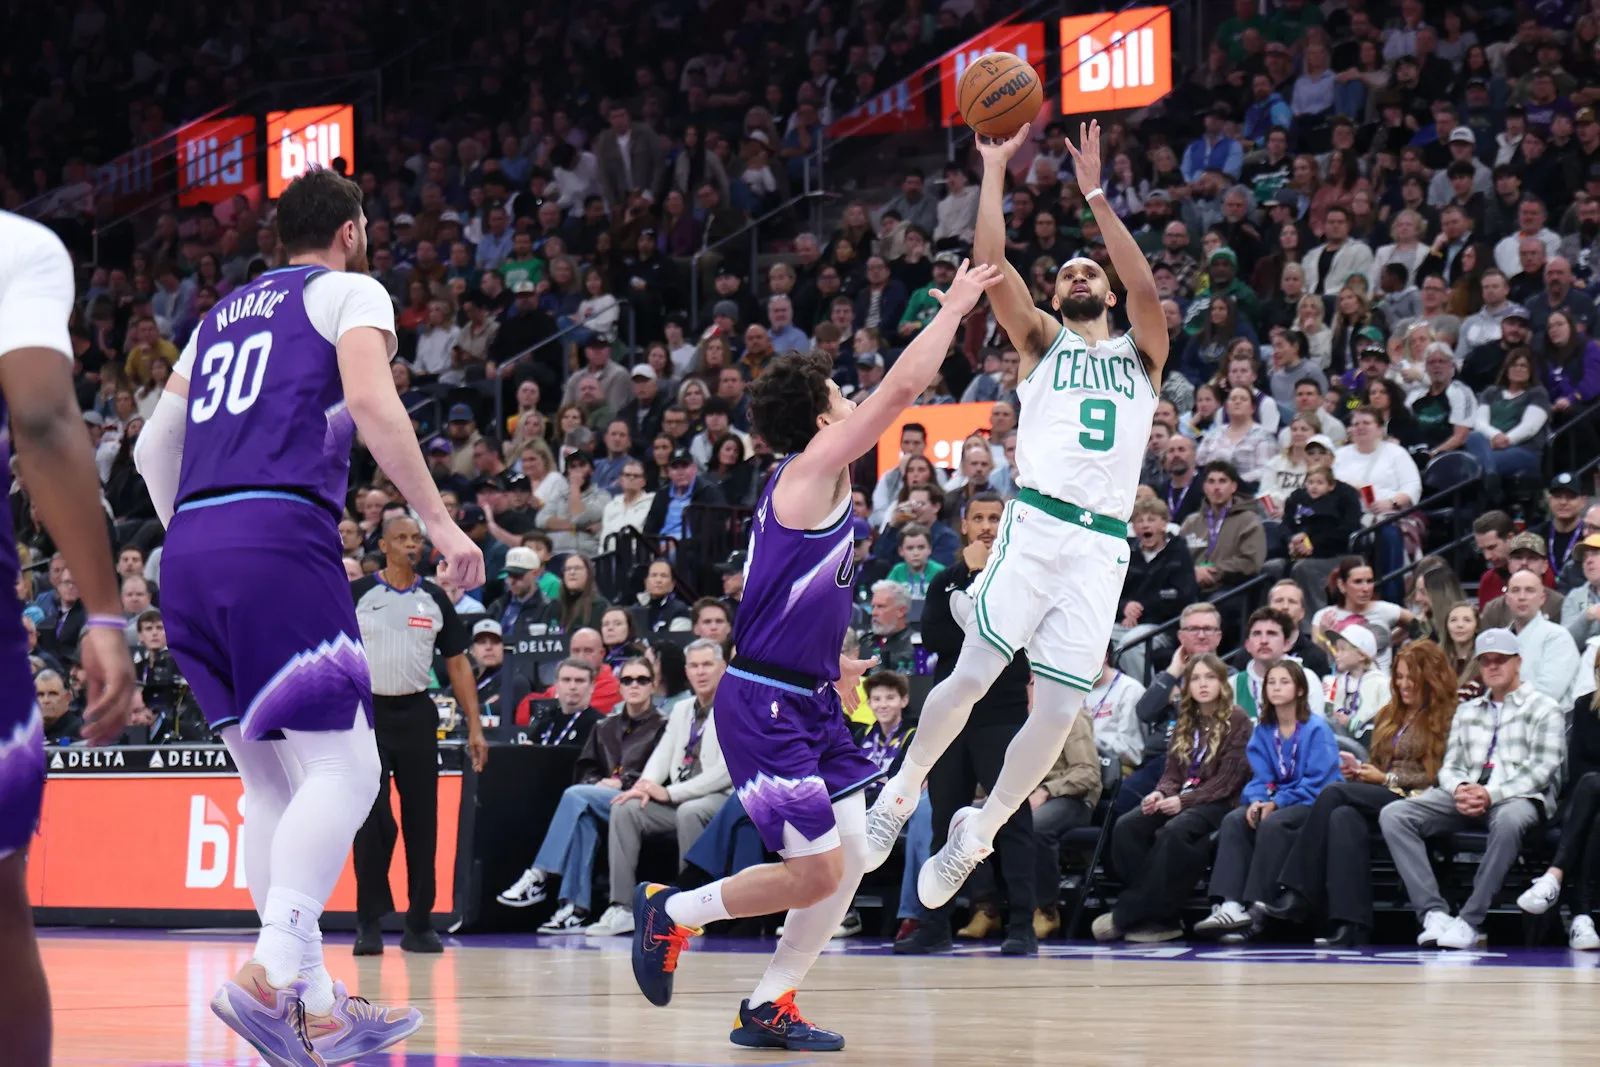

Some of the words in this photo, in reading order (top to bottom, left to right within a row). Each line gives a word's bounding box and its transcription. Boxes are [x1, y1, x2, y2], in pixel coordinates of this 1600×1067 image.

[1079, 28, 1154, 92] bill
[980, 71, 1032, 108] Wilson
[281, 122, 340, 179] bill
[191, 330, 273, 424] 30
[1053, 349, 1136, 400] CELTICS
[1079, 398, 1117, 452] 9
[518, 640, 563, 653] DELTA
[69, 751, 125, 767] DELTA
[168, 750, 227, 767] DELTA
[185, 795, 248, 888] bi
